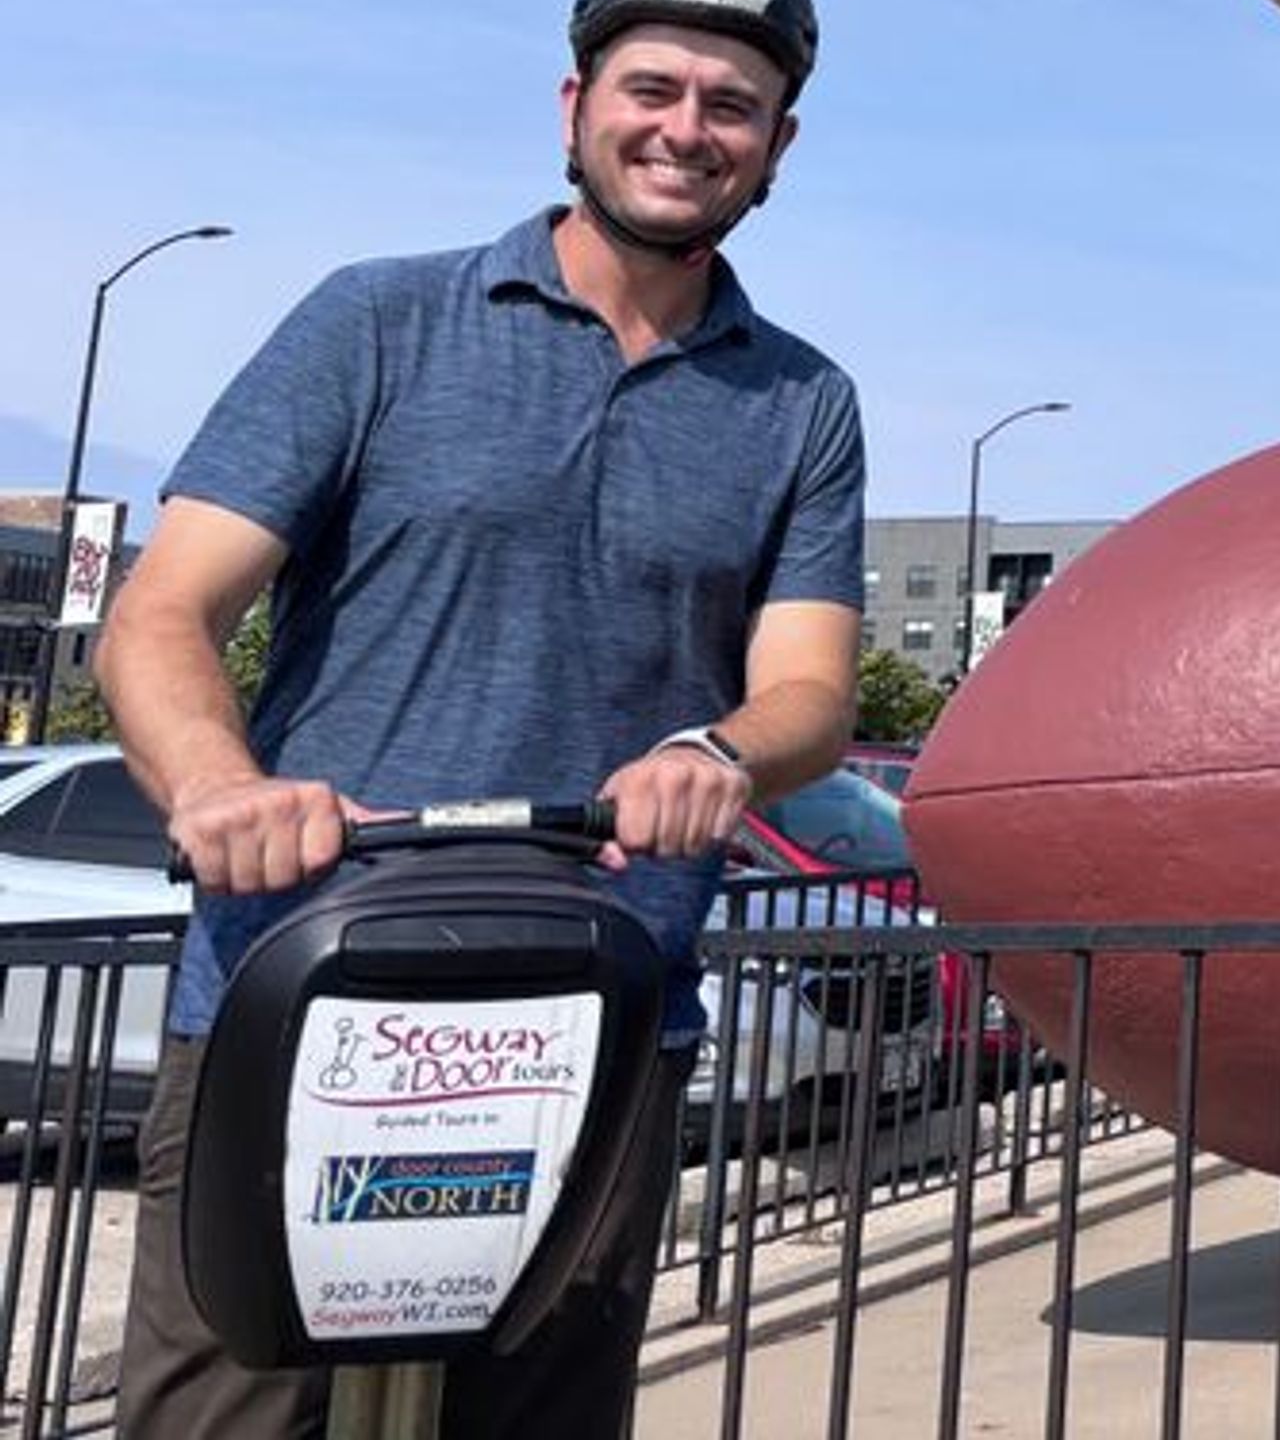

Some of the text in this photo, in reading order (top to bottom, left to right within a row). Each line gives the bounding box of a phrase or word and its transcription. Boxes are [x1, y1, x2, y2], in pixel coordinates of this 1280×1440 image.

[511, 1062, 575, 1082] tours
[370, 1183, 522, 1216] NORTH
[320, 1276, 498, 1302] 920-376-0256
